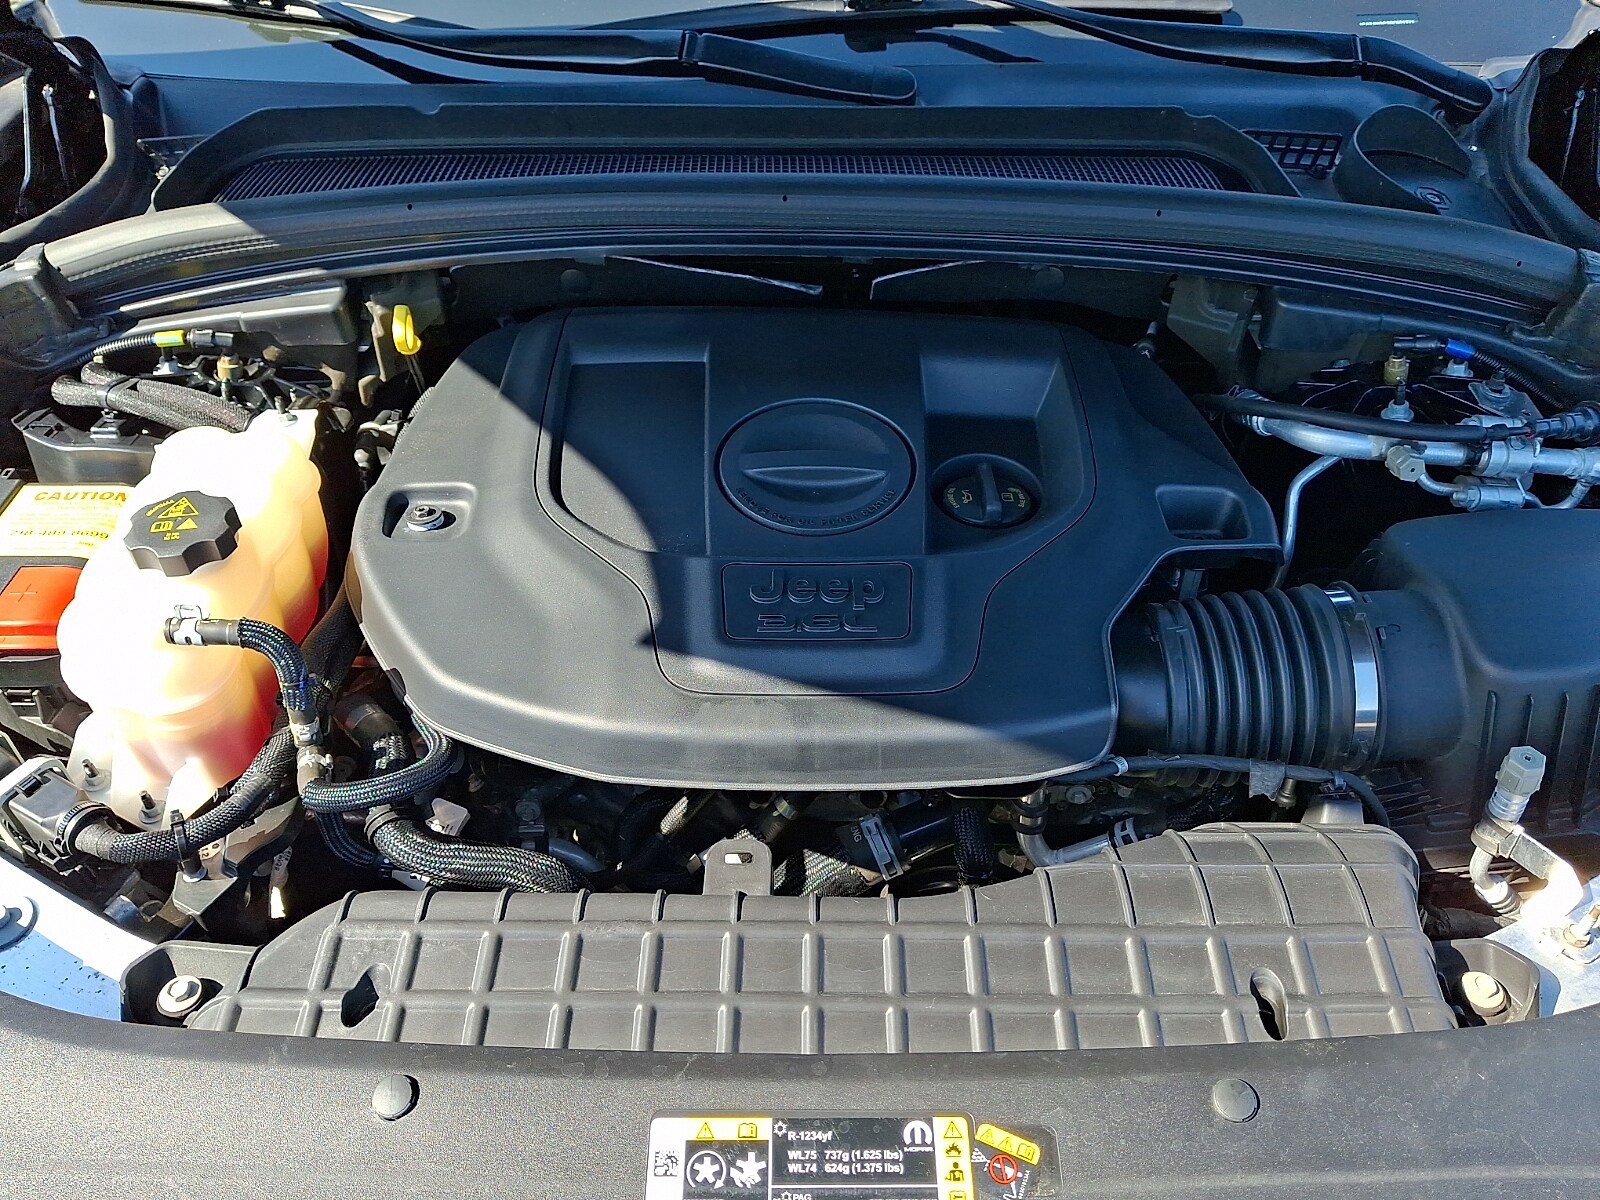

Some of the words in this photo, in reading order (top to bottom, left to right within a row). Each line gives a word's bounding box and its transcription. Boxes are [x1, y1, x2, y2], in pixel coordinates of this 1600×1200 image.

[34, 492, 127, 502] CAUTION
[749, 570, 885, 611] Jeep
[757, 614, 878, 633] 3.6L
[787, 1130, 833, 1142] R-1234yf
[788, 1150, 818, 1160] WL75
[825, 1150, 850, 1162] 737g
[852, 1150, 882, 1162] (1.625
[884, 1150, 904, 1162] lbs)
[788, 1163, 818, 1173] WL74
[825, 1163, 850, 1174] 624g
[852, 1163, 882, 1174] (1.375
[884, 1163, 904, 1174] lbs)
